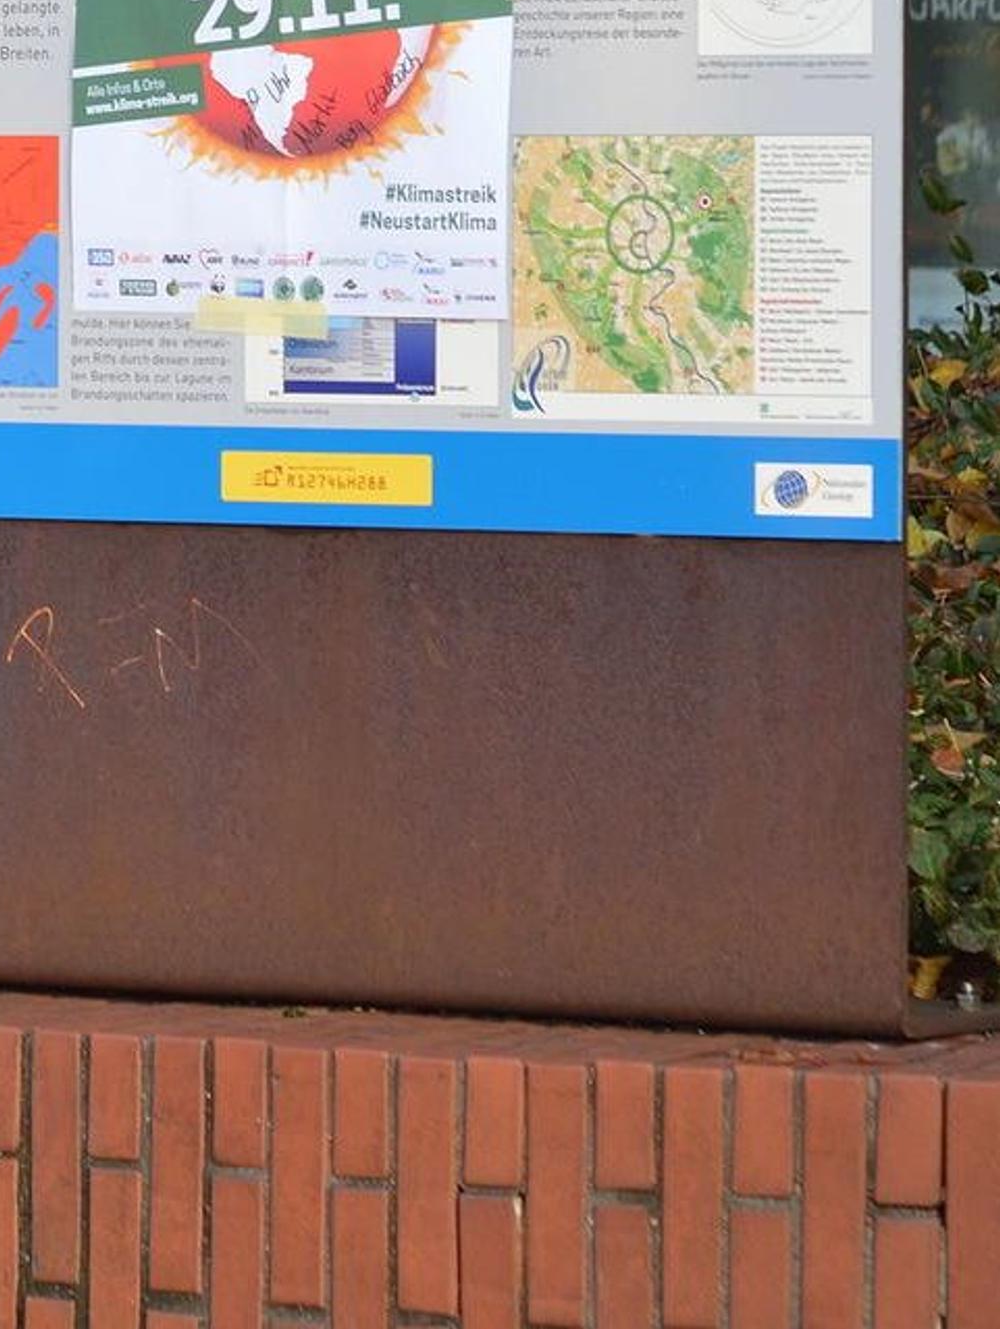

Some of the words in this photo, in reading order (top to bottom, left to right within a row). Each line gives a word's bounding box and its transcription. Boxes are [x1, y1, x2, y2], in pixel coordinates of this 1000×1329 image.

[1, 1, 61, 18] gelangte
[86, 85, 105, 98] Alle
[106, 81, 131, 96] Infos
[142, 78, 166, 92] Orte
[85, 92, 199, 115] www.klima-streik.org
[385, 183, 497, 205] #Klimastreik
[359, 211, 498, 232] #NeustartKlima
